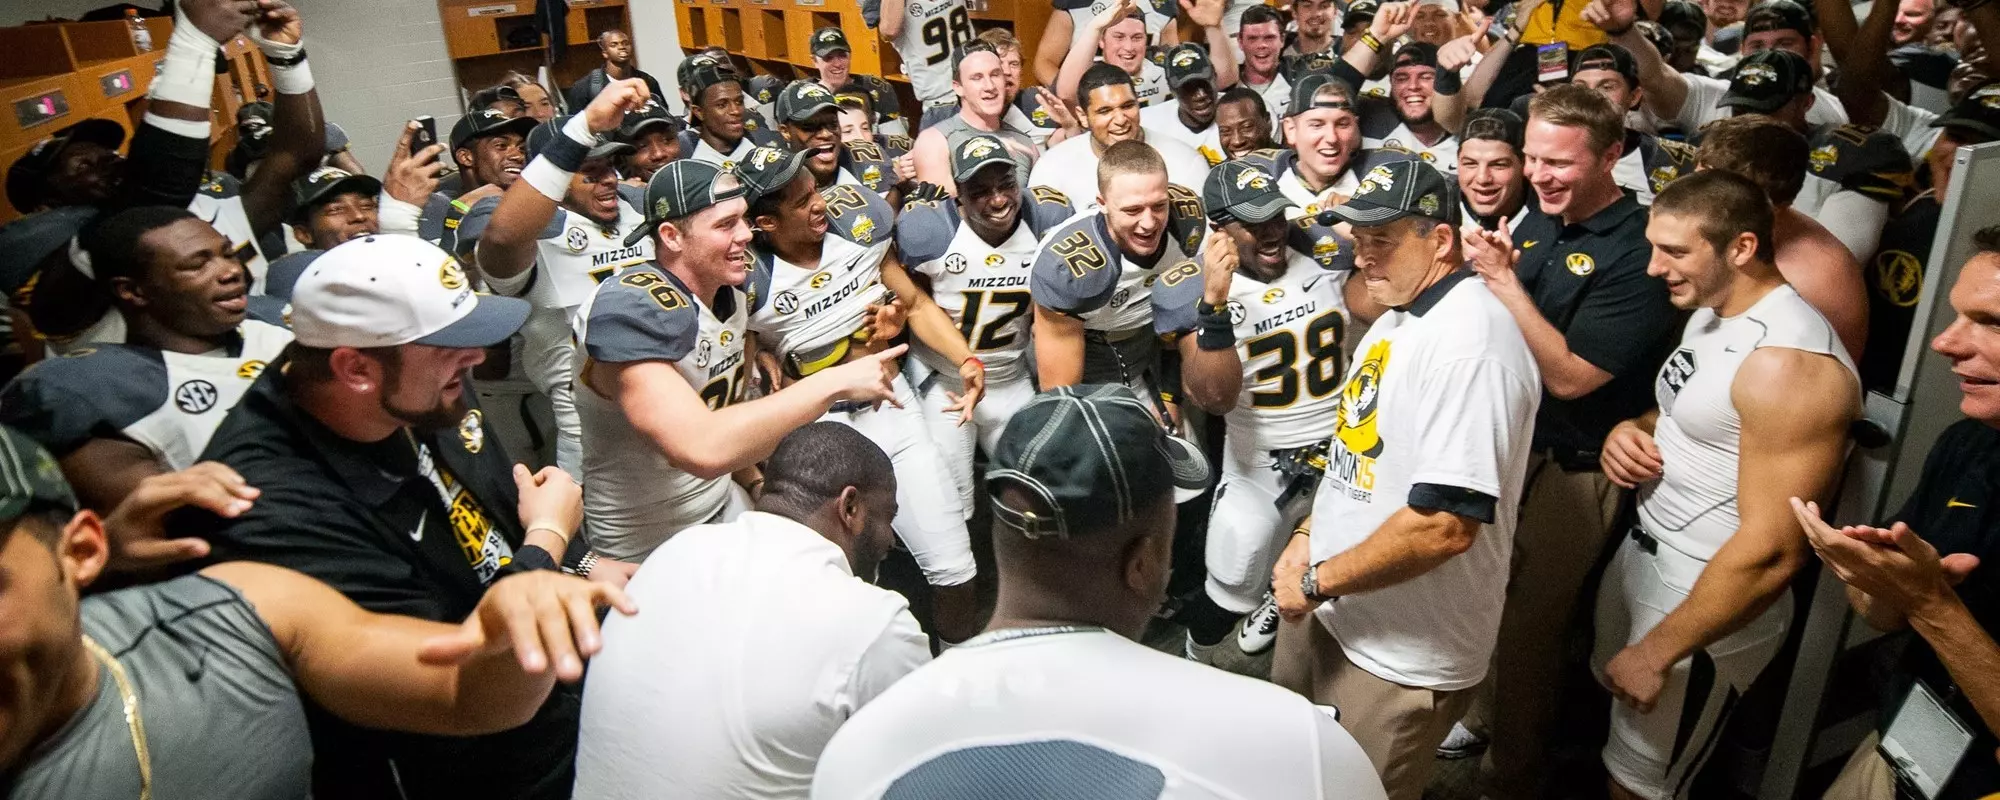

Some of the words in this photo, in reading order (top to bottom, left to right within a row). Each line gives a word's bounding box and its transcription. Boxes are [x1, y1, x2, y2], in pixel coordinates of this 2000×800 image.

[922, 5, 972, 66] 98
[592, 246, 643, 266] MIZZOU
[1051, 230, 1107, 279] 32
[620, 271, 690, 312] 86
[804, 278, 860, 320] MIZZOU
[968, 276, 1027, 288] MIZZOU
[960, 289, 1032, 351] 12
[1254, 301, 1316, 335] MIZZOU
[1244, 308, 1345, 409] 38
[175, 379, 218, 414] SEC
